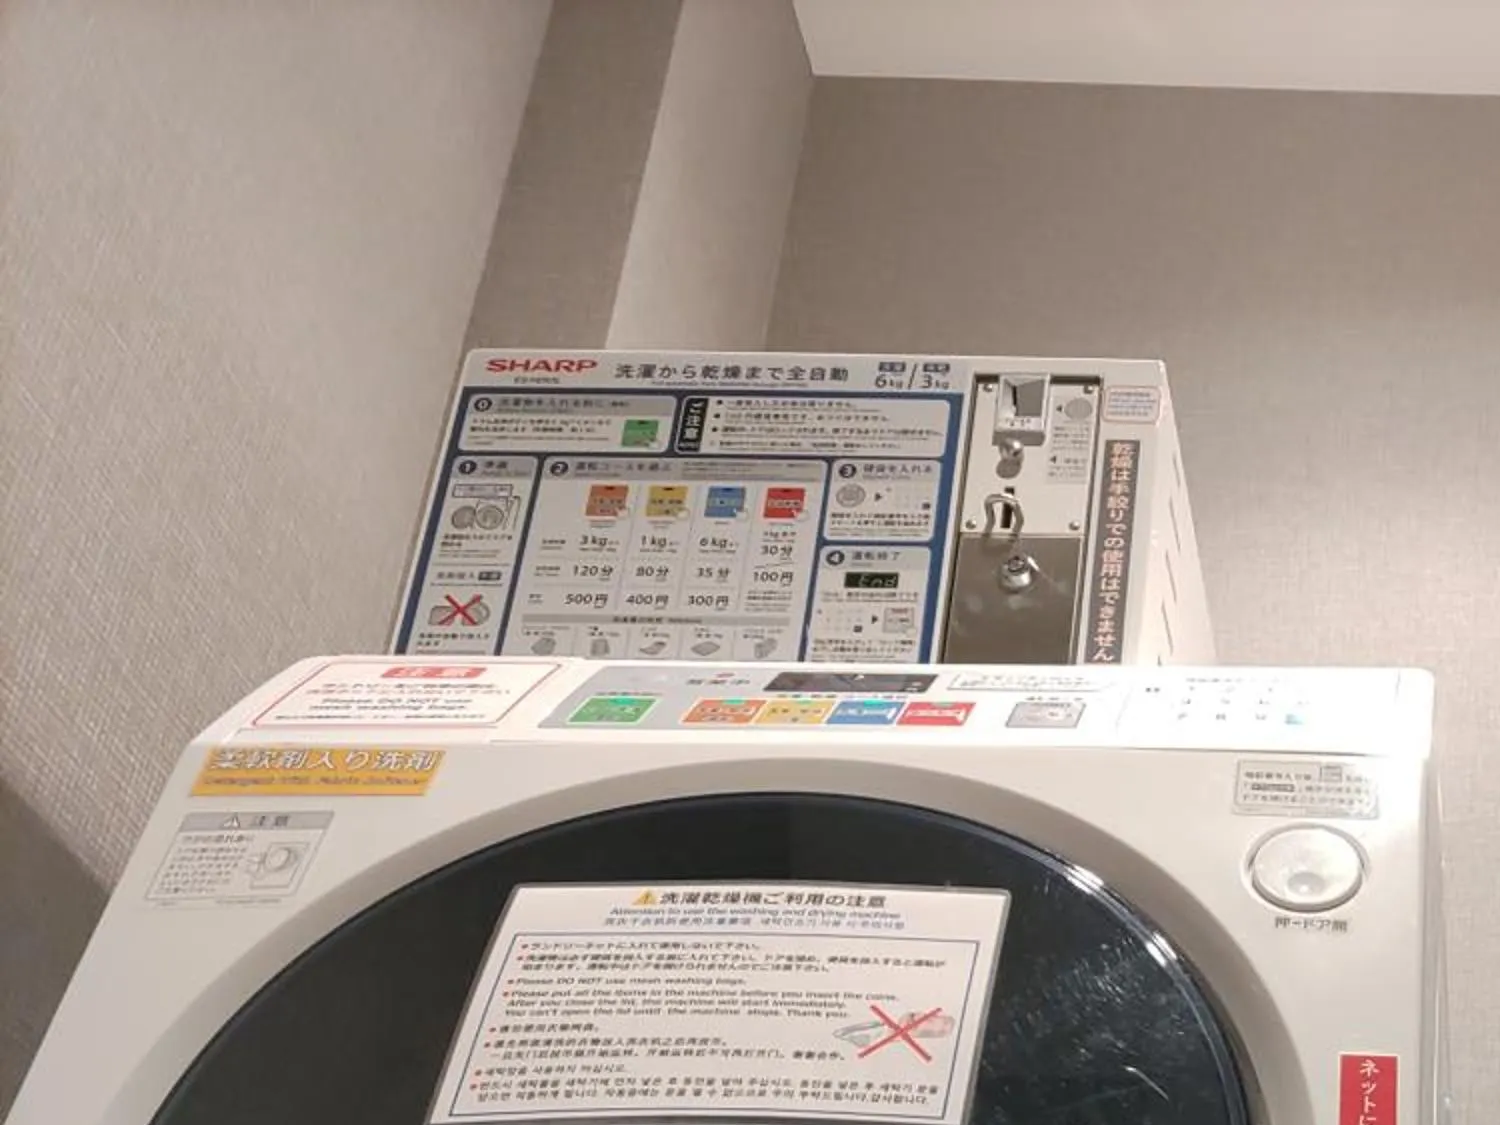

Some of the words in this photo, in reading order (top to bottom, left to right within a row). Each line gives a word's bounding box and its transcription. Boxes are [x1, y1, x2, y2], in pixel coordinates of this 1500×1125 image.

[486, 358, 598, 373] SHARP
[614, 362, 849, 382] 洗濯から乾燥まで全自動
[1092, 441, 1137, 663] 乾燥は手絞りでの使用はできません
[563, 593, 609, 609] 500円
[625, 594, 670, 609] 400円
[211, 750, 443, 771] 柔軟剤入り洗剤
[659, 891, 886, 908] 洗濯乾燥機ご利用の注意
